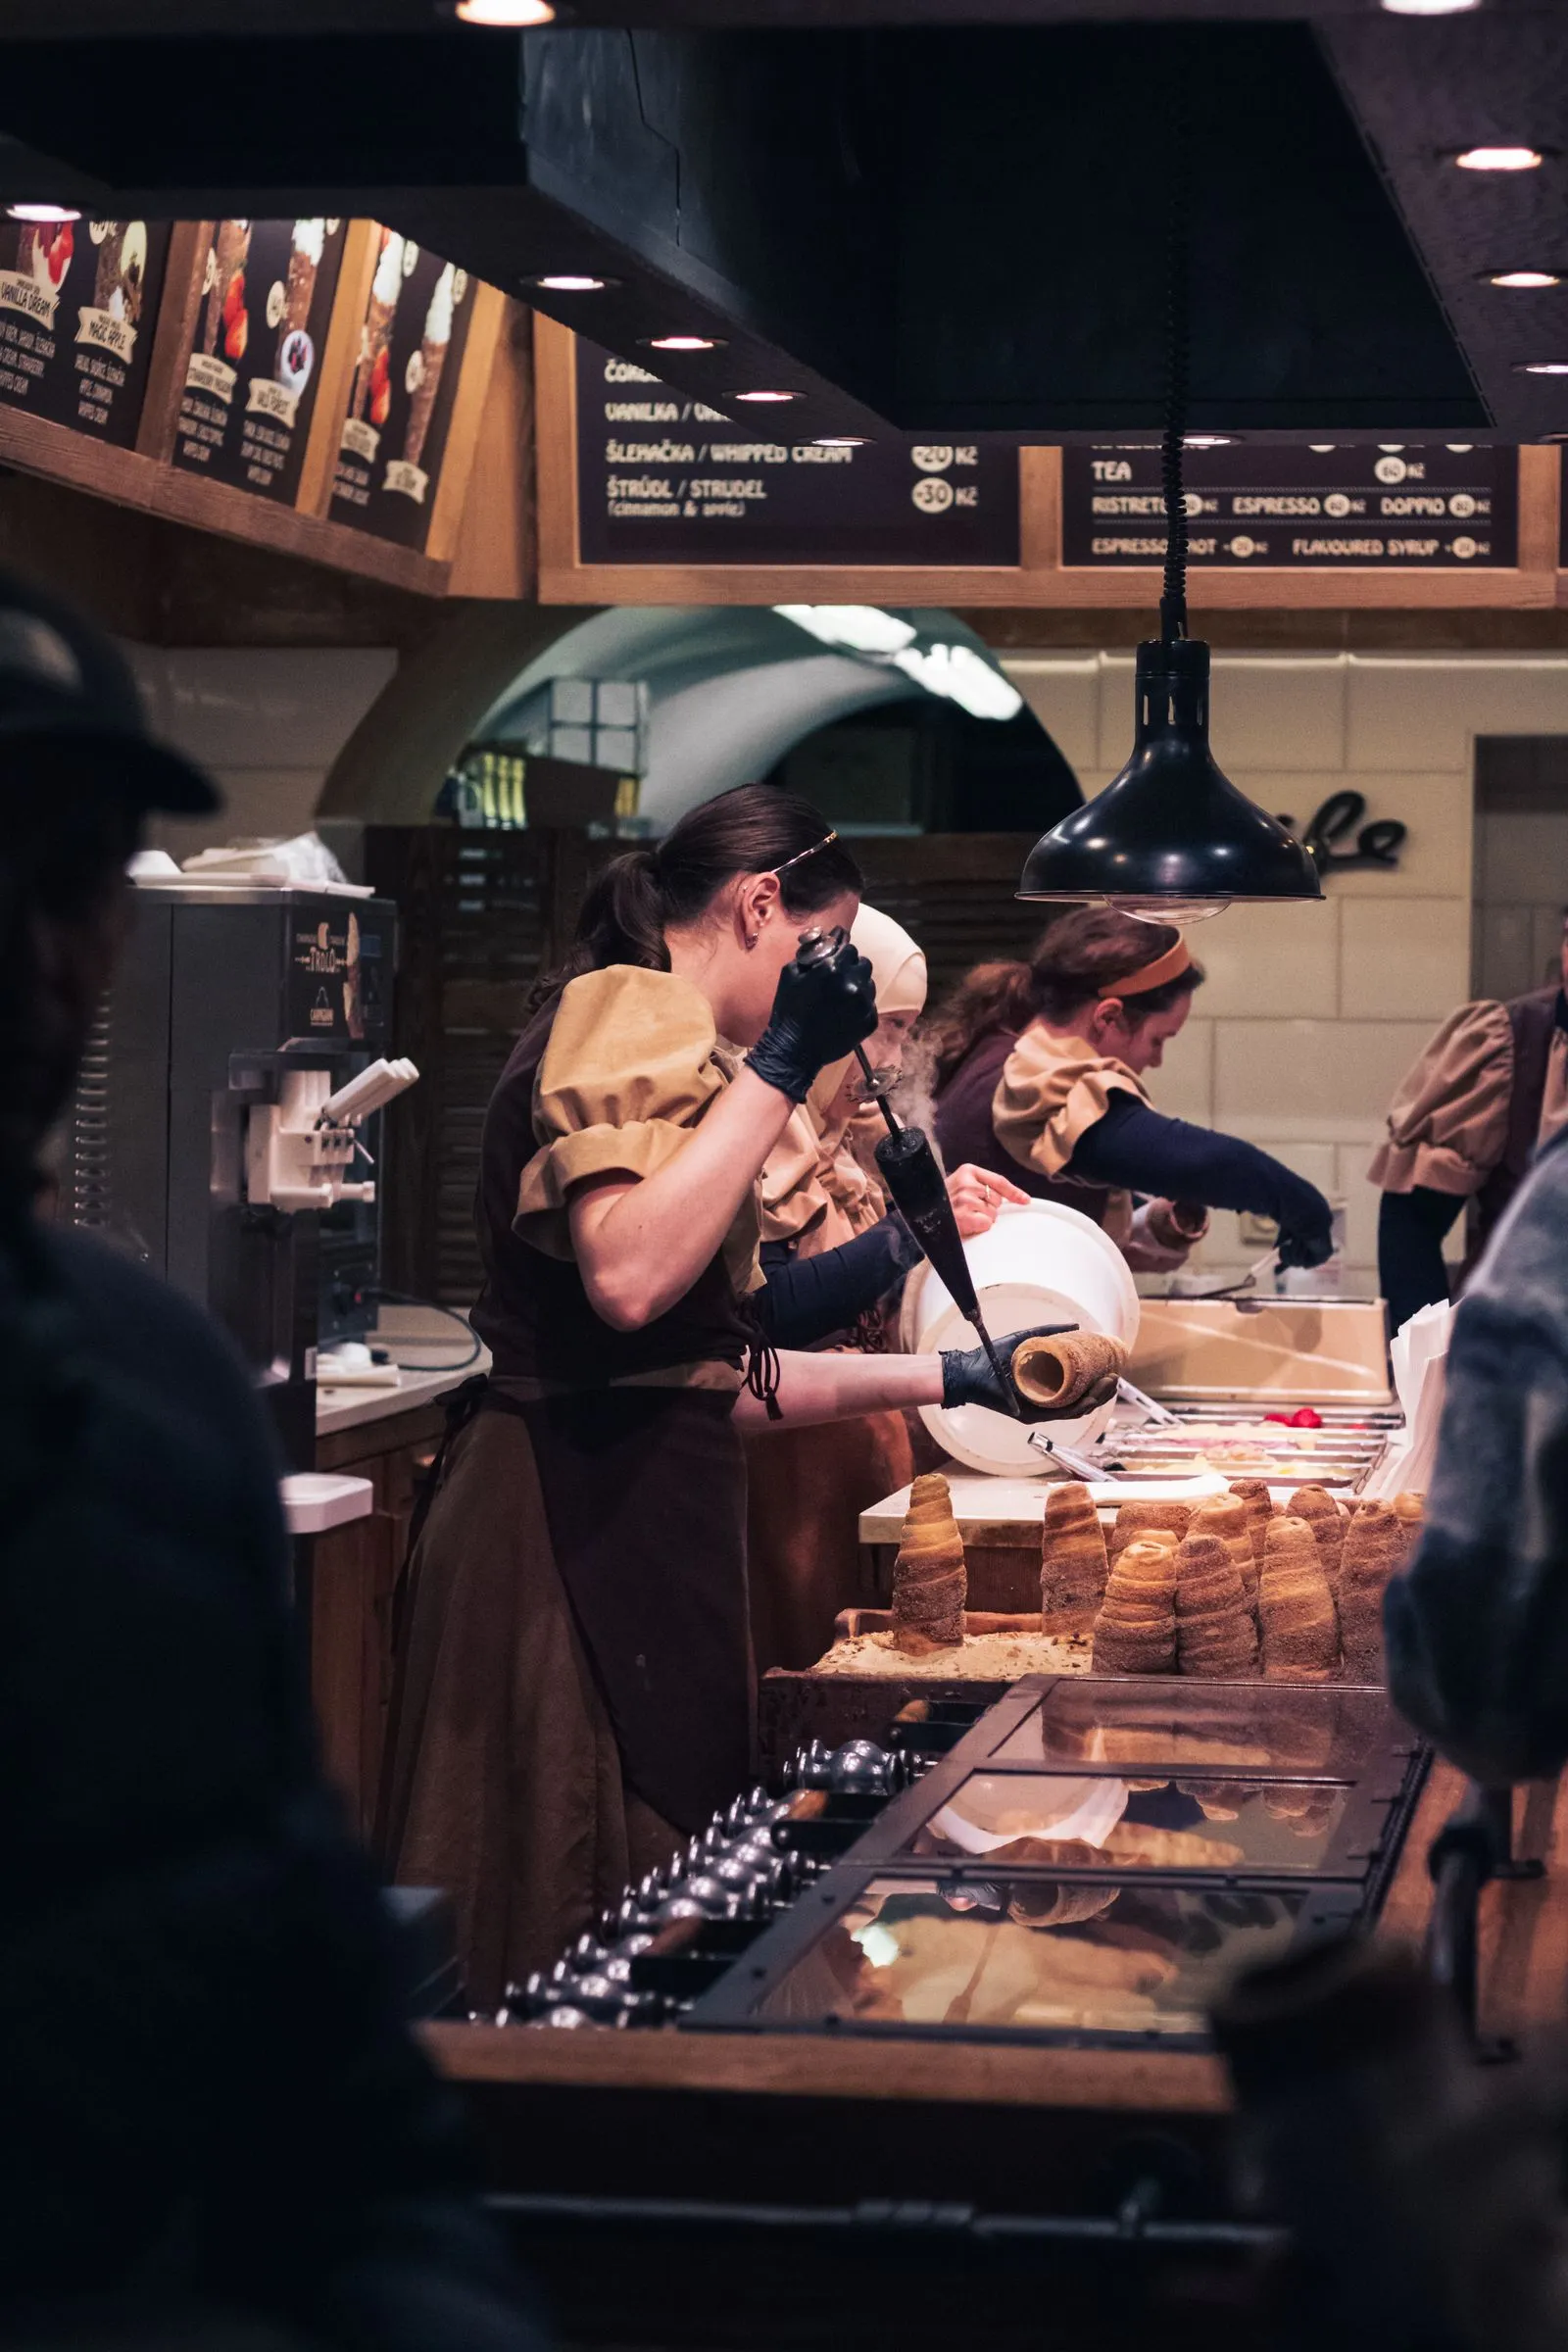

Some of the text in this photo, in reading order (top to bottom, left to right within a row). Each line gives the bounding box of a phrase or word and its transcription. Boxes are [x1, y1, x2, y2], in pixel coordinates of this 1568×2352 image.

[710, 444, 788, 463] WHIPPED
[792, 446, 853, 463] CREAM
[1092, 461, 1132, 481] TEA
[690, 479, 767, 499] STRUDEL
[1233, 496, 1321, 515] ESPRESSO
[1380, 496, 1446, 515] DOPPIO
[1293, 538, 1384, 557] FLAVOURED
[1387, 538, 1440, 557] SYRUP
